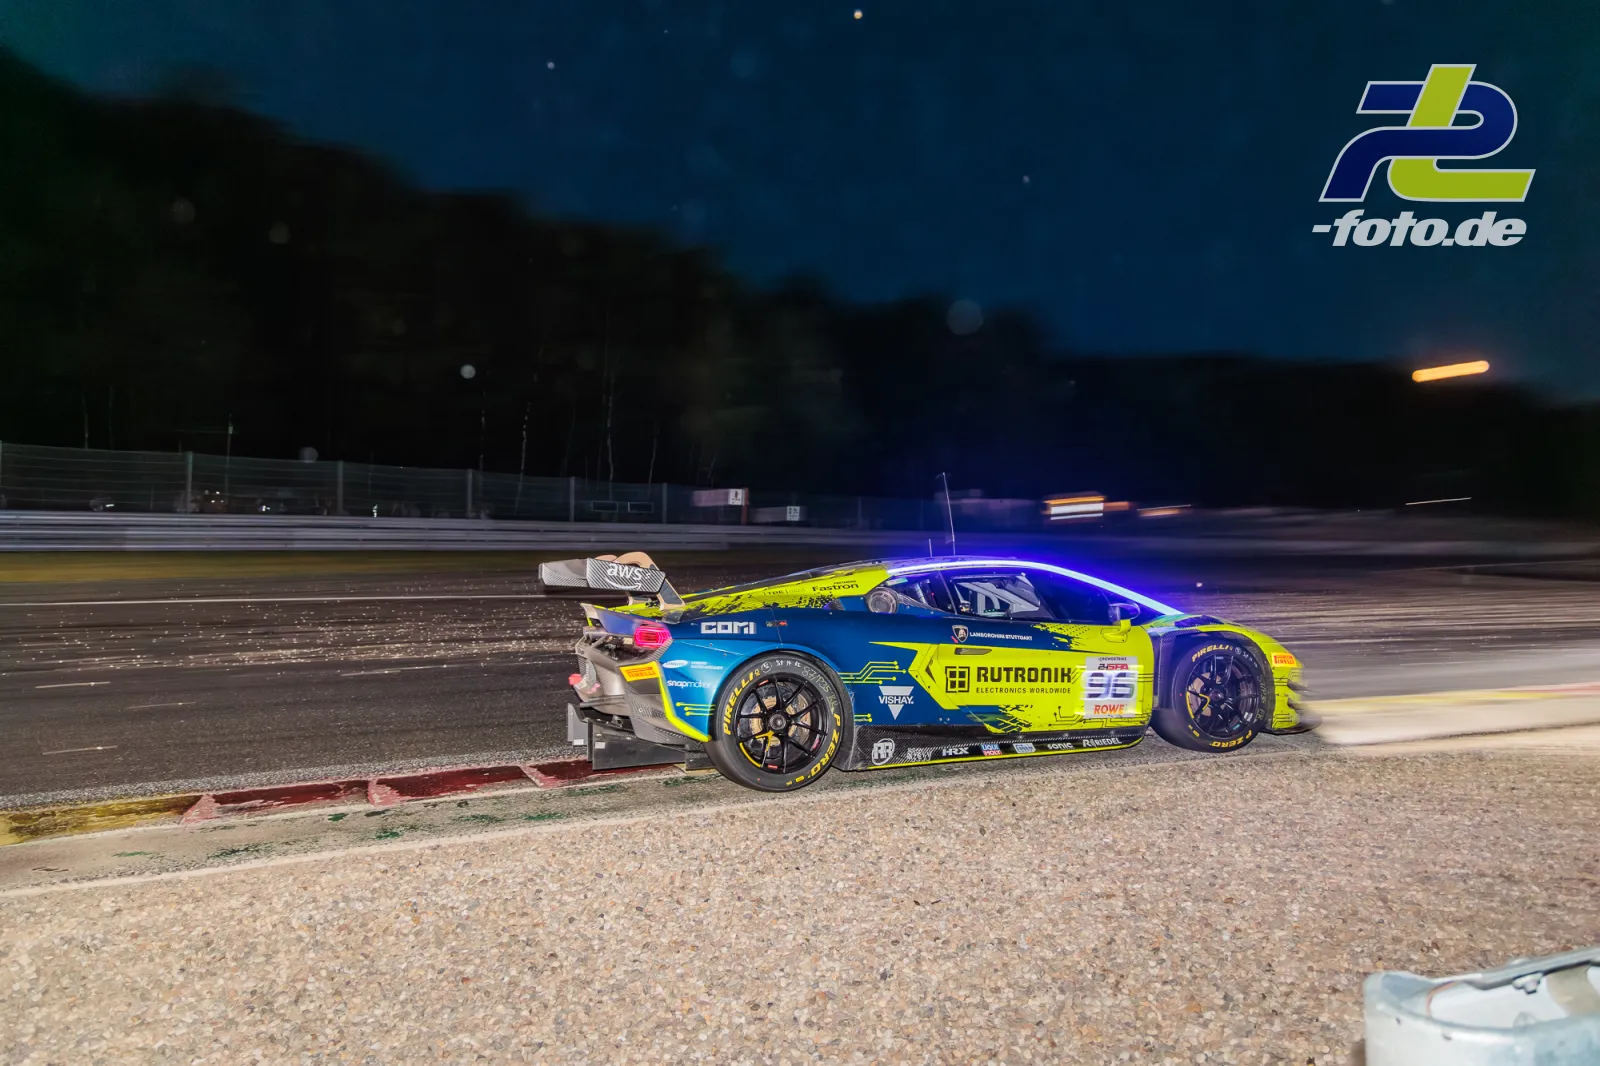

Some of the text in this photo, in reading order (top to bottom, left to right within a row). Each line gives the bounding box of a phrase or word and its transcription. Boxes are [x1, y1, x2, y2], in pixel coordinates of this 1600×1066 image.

[607, 563, 643, 581] aws
[812, 583, 859, 592] Fastron
[969, 631, 1005, 639] LAMBORGHINI
[1191, 643, 1230, 663] PIRELLI
[1273, 655, 1296, 665] PIRELLI
[976, 666, 1072, 683] RUTRONIK
[1086, 671, 1136, 699] 96
[722, 671, 754, 736] PIRELLI
[878, 695, 914, 705] VISHAY
[1093, 704, 1125, 715] ROWE
[810, 713, 841, 777] P ZERO
[1211, 729, 1253, 748] P ZERO
[941, 747, 969, 757] HRX
